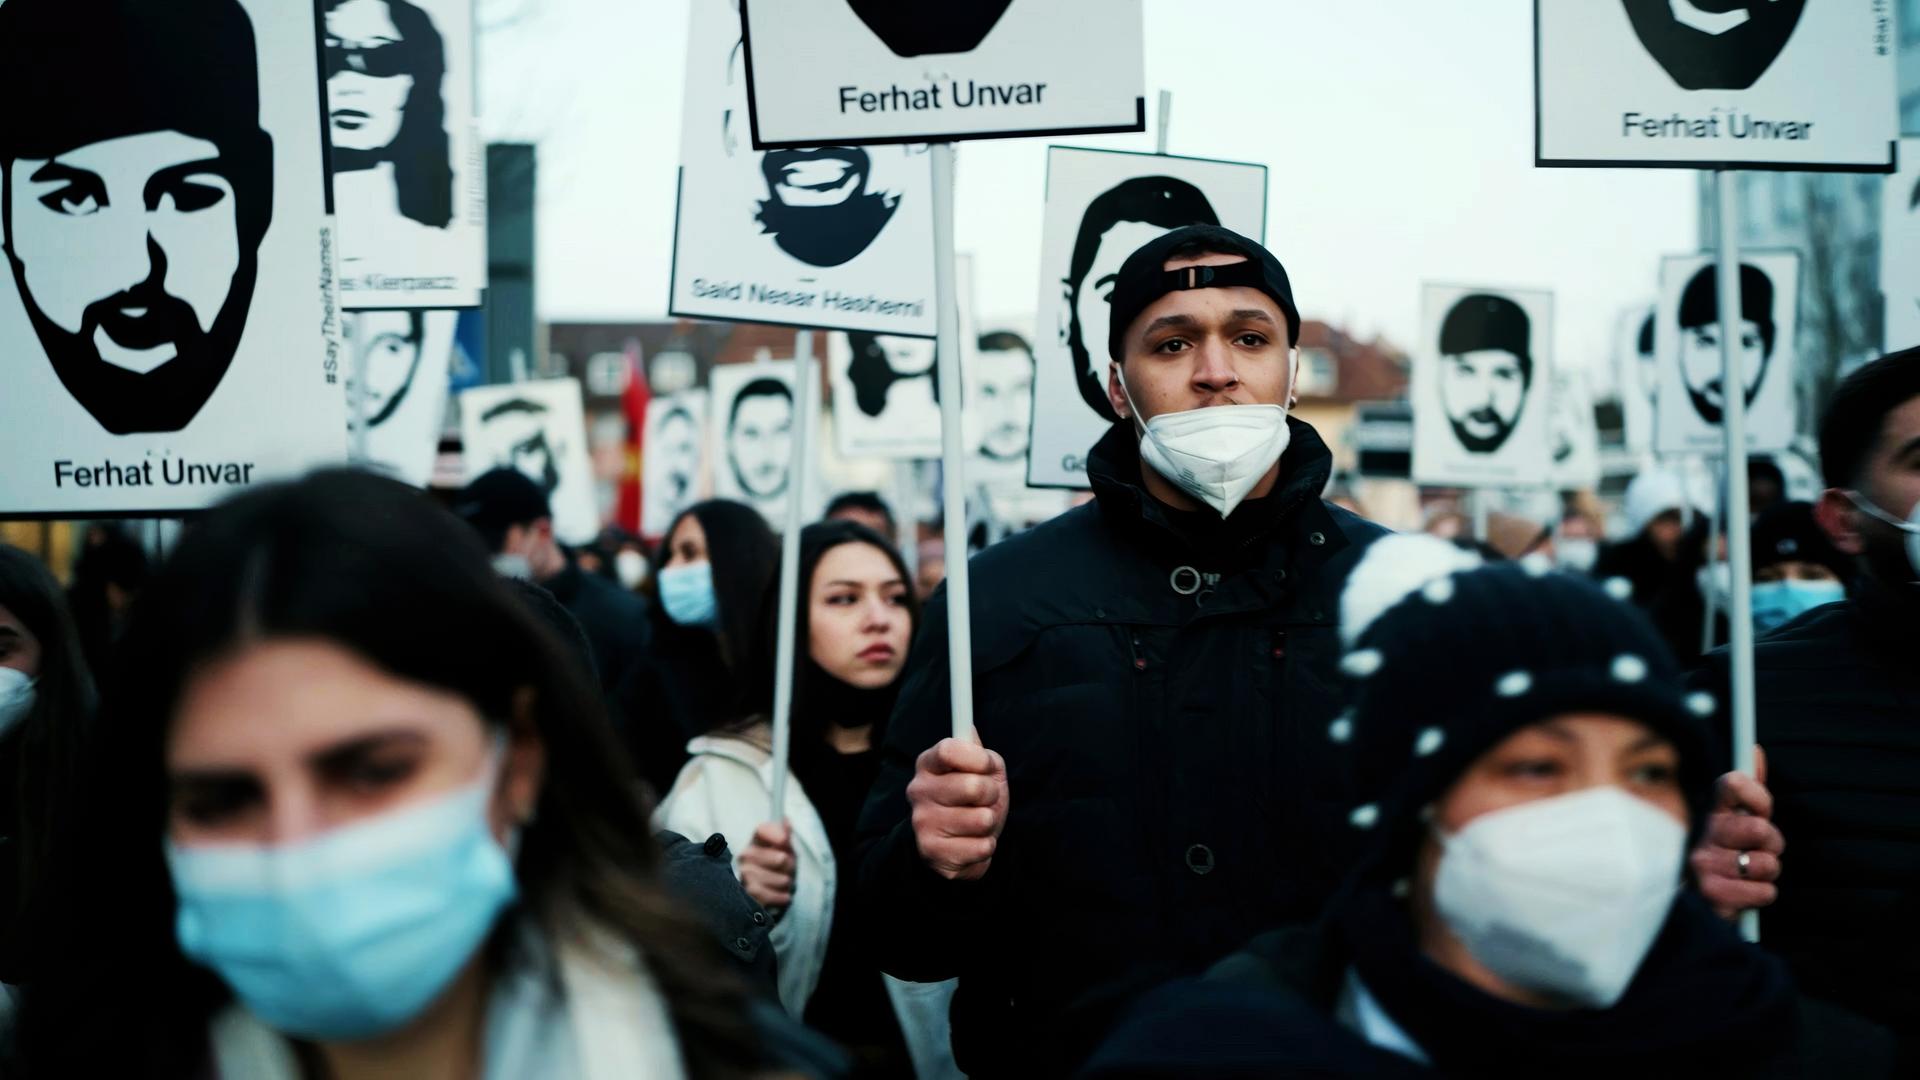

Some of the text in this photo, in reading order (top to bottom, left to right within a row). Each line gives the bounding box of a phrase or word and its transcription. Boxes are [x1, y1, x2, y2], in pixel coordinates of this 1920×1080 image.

[840, 80, 1047, 113] Ferhat Unvar
[1622, 112, 1814, 140] Ferhat Unvar
[319, 227, 339, 384] #SayTheirNames
[692, 278, 925, 317] Said Nesar Hashemi
[54, 458, 254, 488] Ferhat Unvar
